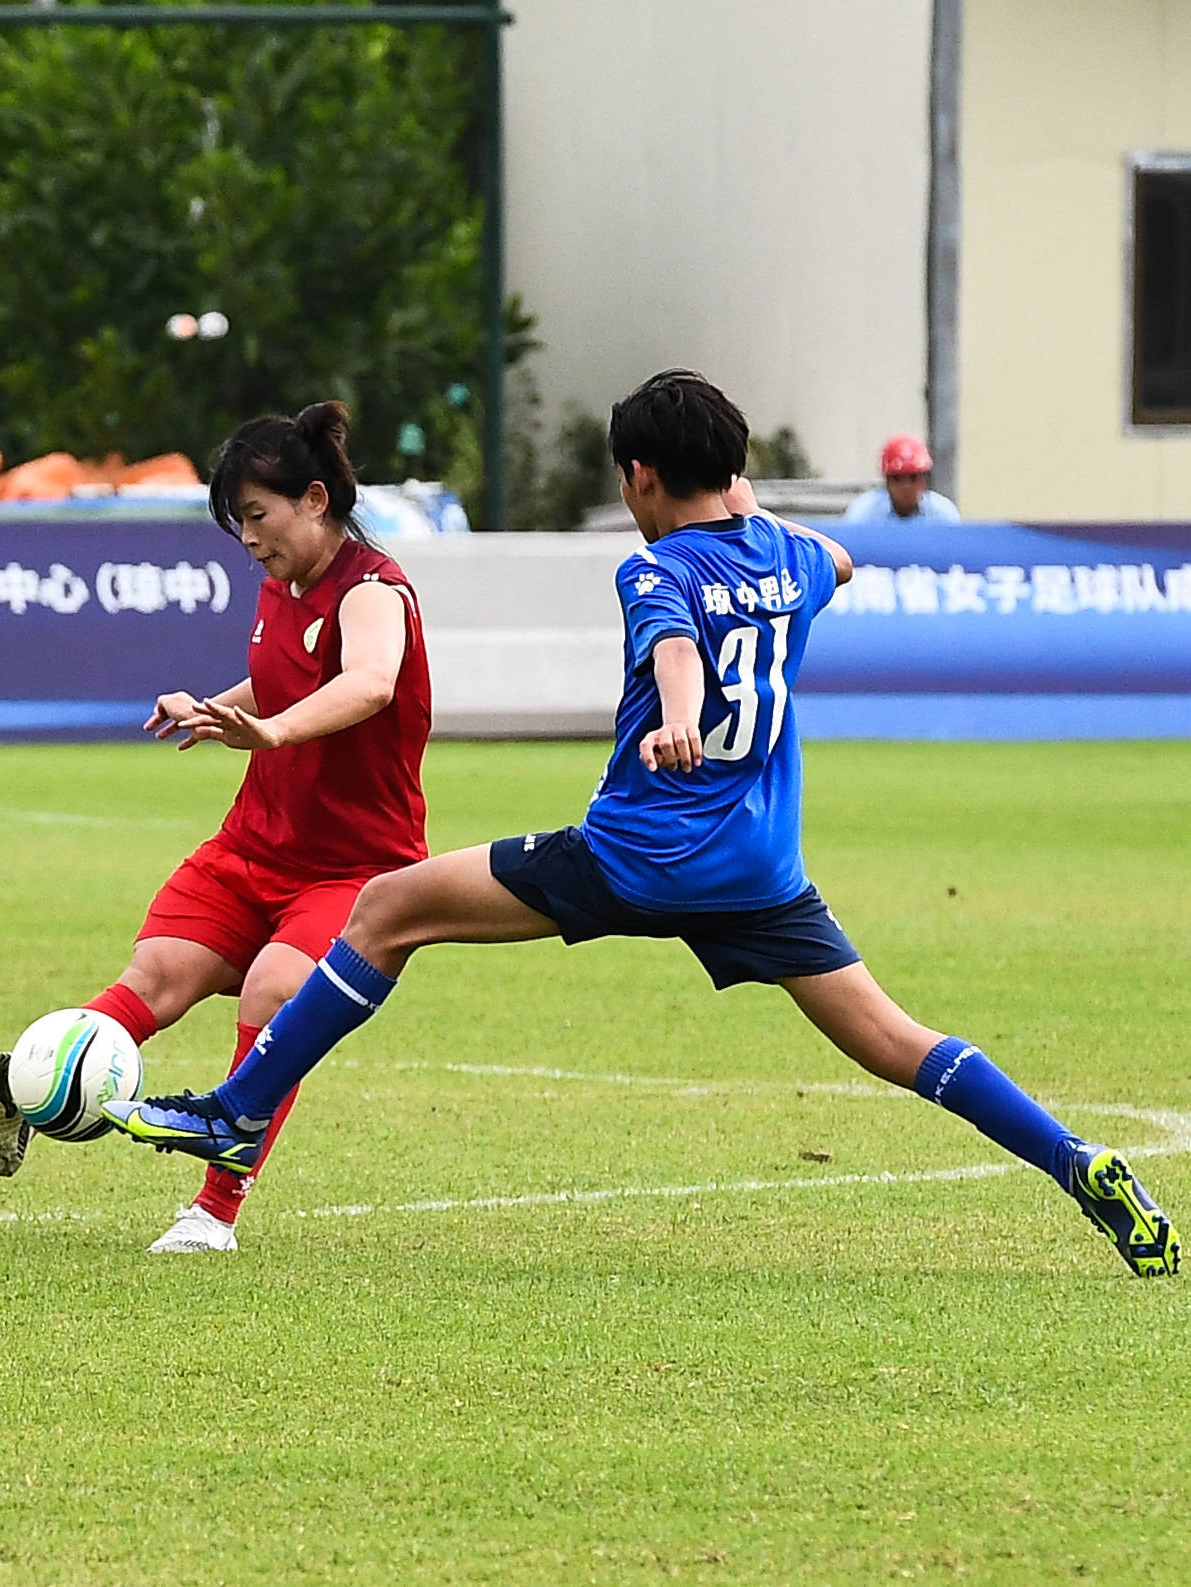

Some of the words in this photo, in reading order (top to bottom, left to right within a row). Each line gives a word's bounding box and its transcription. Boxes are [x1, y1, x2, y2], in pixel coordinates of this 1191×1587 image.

[701, 567, 802, 616] 琼中男足
[703, 614, 791, 761] 31
